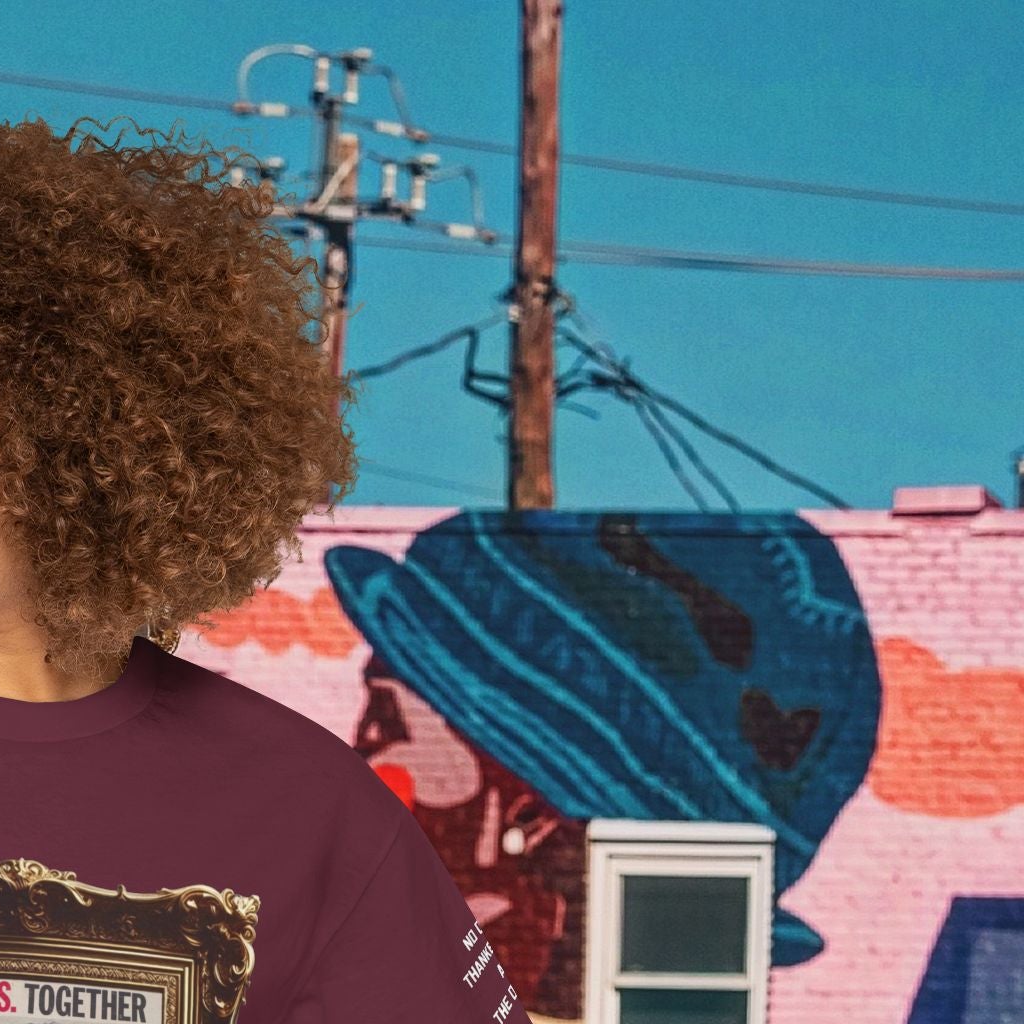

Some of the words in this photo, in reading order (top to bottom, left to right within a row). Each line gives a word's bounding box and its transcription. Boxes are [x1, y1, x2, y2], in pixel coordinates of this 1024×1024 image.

[462, 929, 478, 951] NO
[25, 982, 147, 1023] TOGETHER
[493, 995, 512, 1024] THE
